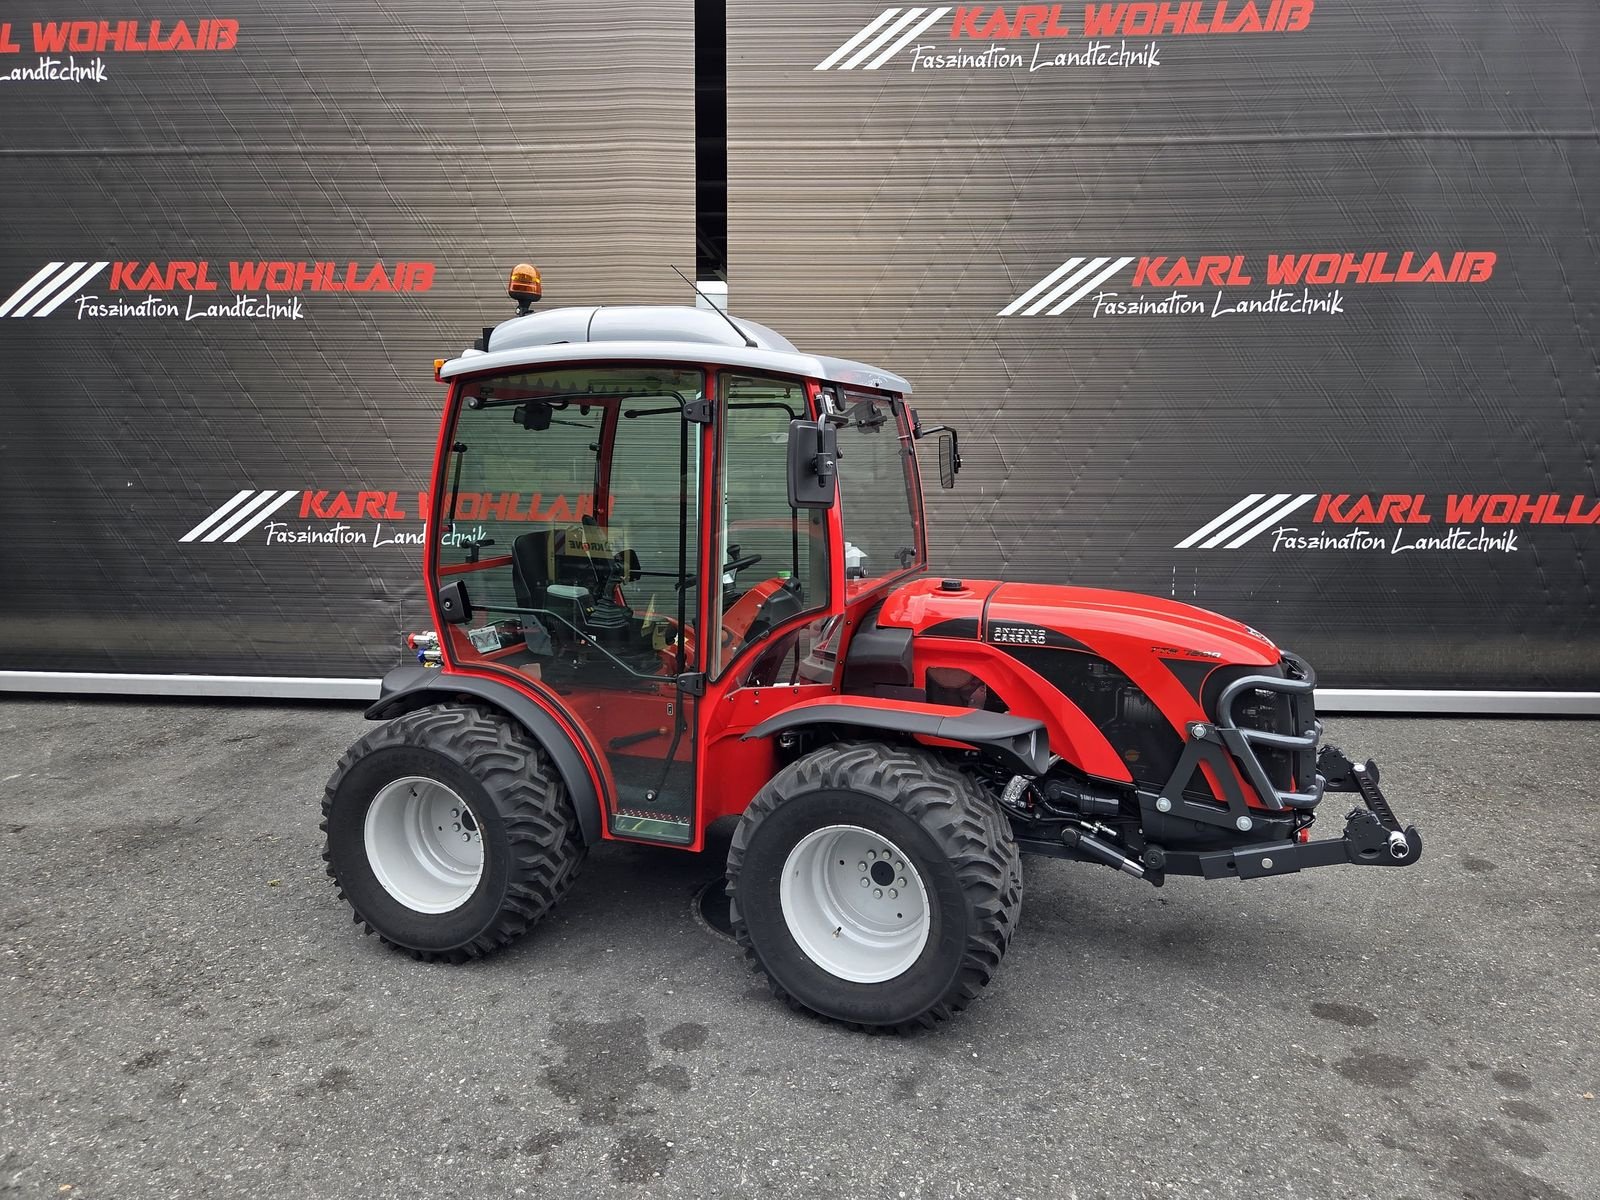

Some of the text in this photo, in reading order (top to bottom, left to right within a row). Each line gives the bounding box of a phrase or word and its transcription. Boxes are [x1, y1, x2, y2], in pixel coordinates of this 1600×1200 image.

[950, 4, 1069, 39] KARL
[909, 40, 1161, 72] Faszination Landtechnik
[109, 262, 218, 291] KARL
[1132, 255, 1252, 288] KARL
[75, 294, 304, 321] Faszination Landtechnik
[1091, 288, 1344, 318] Faszination Landtechnik
[299, 490, 406, 520] KARL
[1313, 494, 1431, 524] KARL
[263, 521, 367, 546] Faszination
[1271, 526, 1518, 554] Faszination Landtechnik
[993, 633, 1046, 644] CARRARO
[994, 627, 1046, 636] ANTONIO
